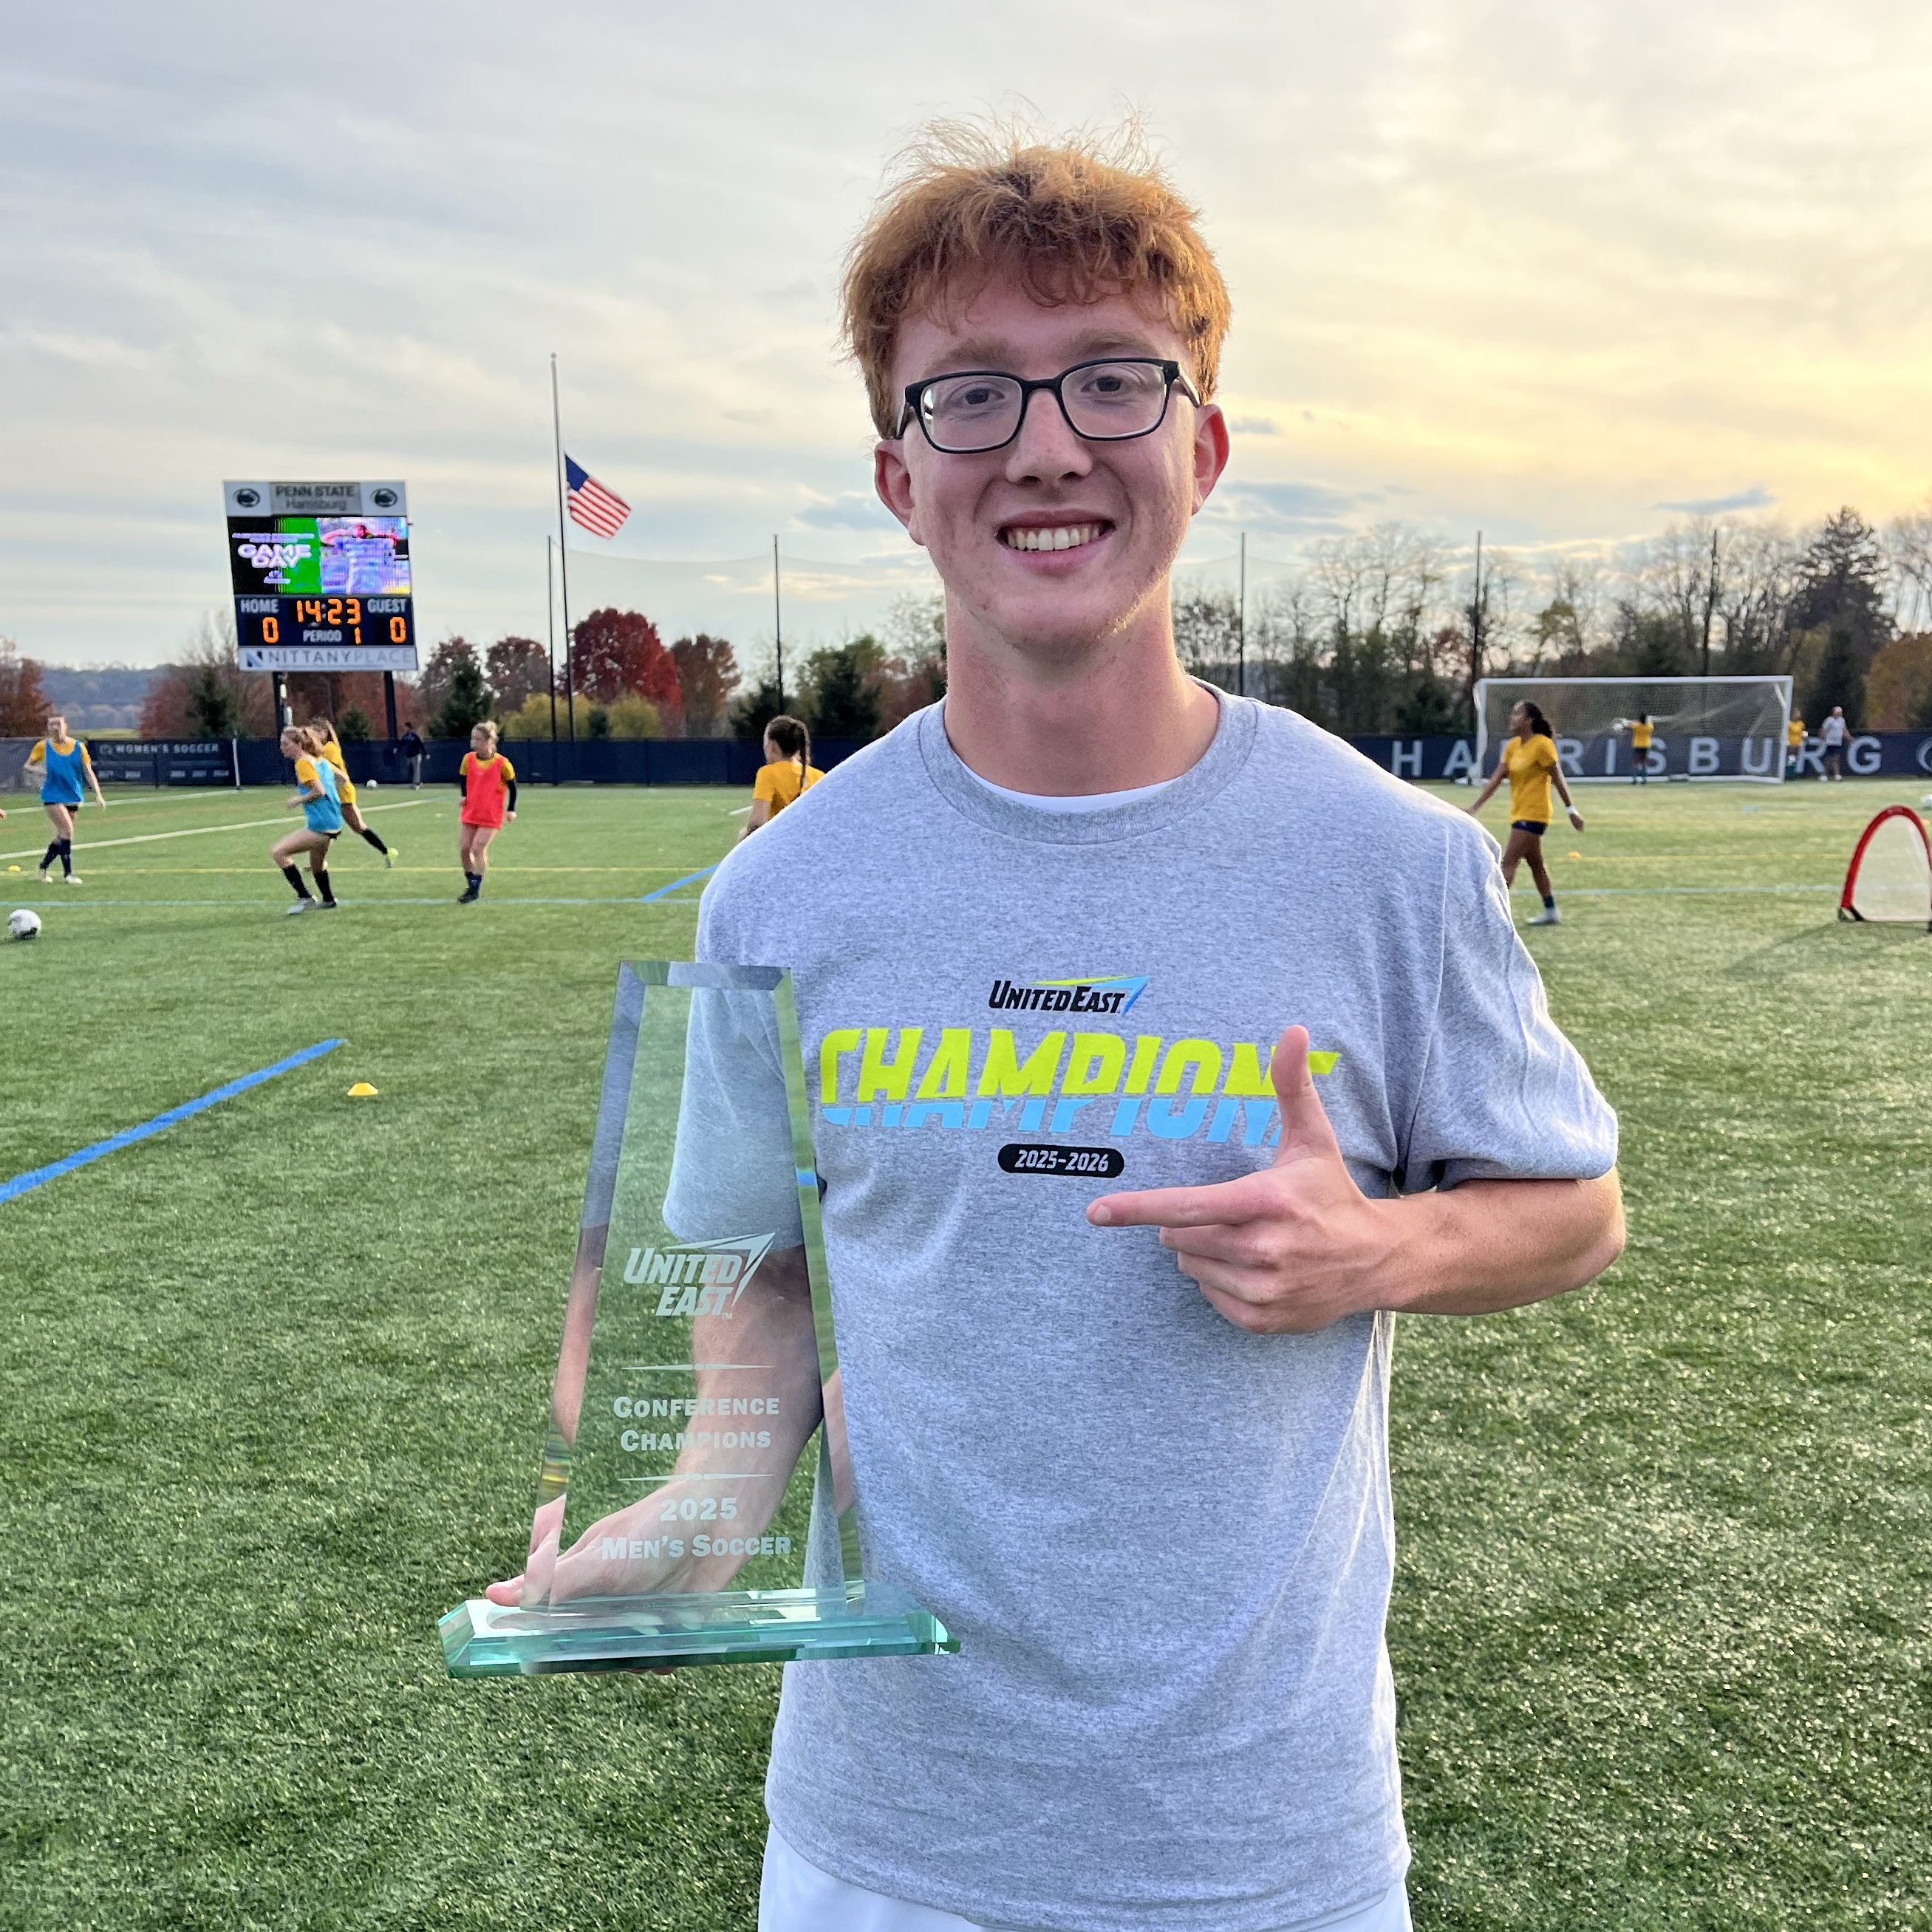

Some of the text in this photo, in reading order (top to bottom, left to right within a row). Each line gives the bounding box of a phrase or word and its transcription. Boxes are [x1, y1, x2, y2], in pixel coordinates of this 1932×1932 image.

[276, 485, 355, 497] PENN STATE
[238, 543, 312, 559] GAME
[251, 556, 301, 568] DAY
[240, 598, 279, 614] HOME
[296, 598, 361, 625] 14:23
[367, 598, 406, 613] GUEST
[262, 616, 279, 644] 0
[302, 629, 343, 642] PERIOD
[354, 627, 361, 645] 1
[389, 616, 406, 644] 0
[173, 743, 219, 754] SOCCER
[1392, 737, 1882, 776] HARISBURG
[819, 1028, 1340, 1147] CHAMPION
[1014, 1149, 1109, 1172] 2025-2026
[623, 1247, 743, 1284] UNITED
[655, 1286, 734, 1317] EAST
[613, 1396, 779, 1418] CONFERENCE
[621, 1430, 771, 1452] CHAMPIONS
[659, 1498, 737, 1522] 2025
[692, 1534, 791, 1557] SOCCER
